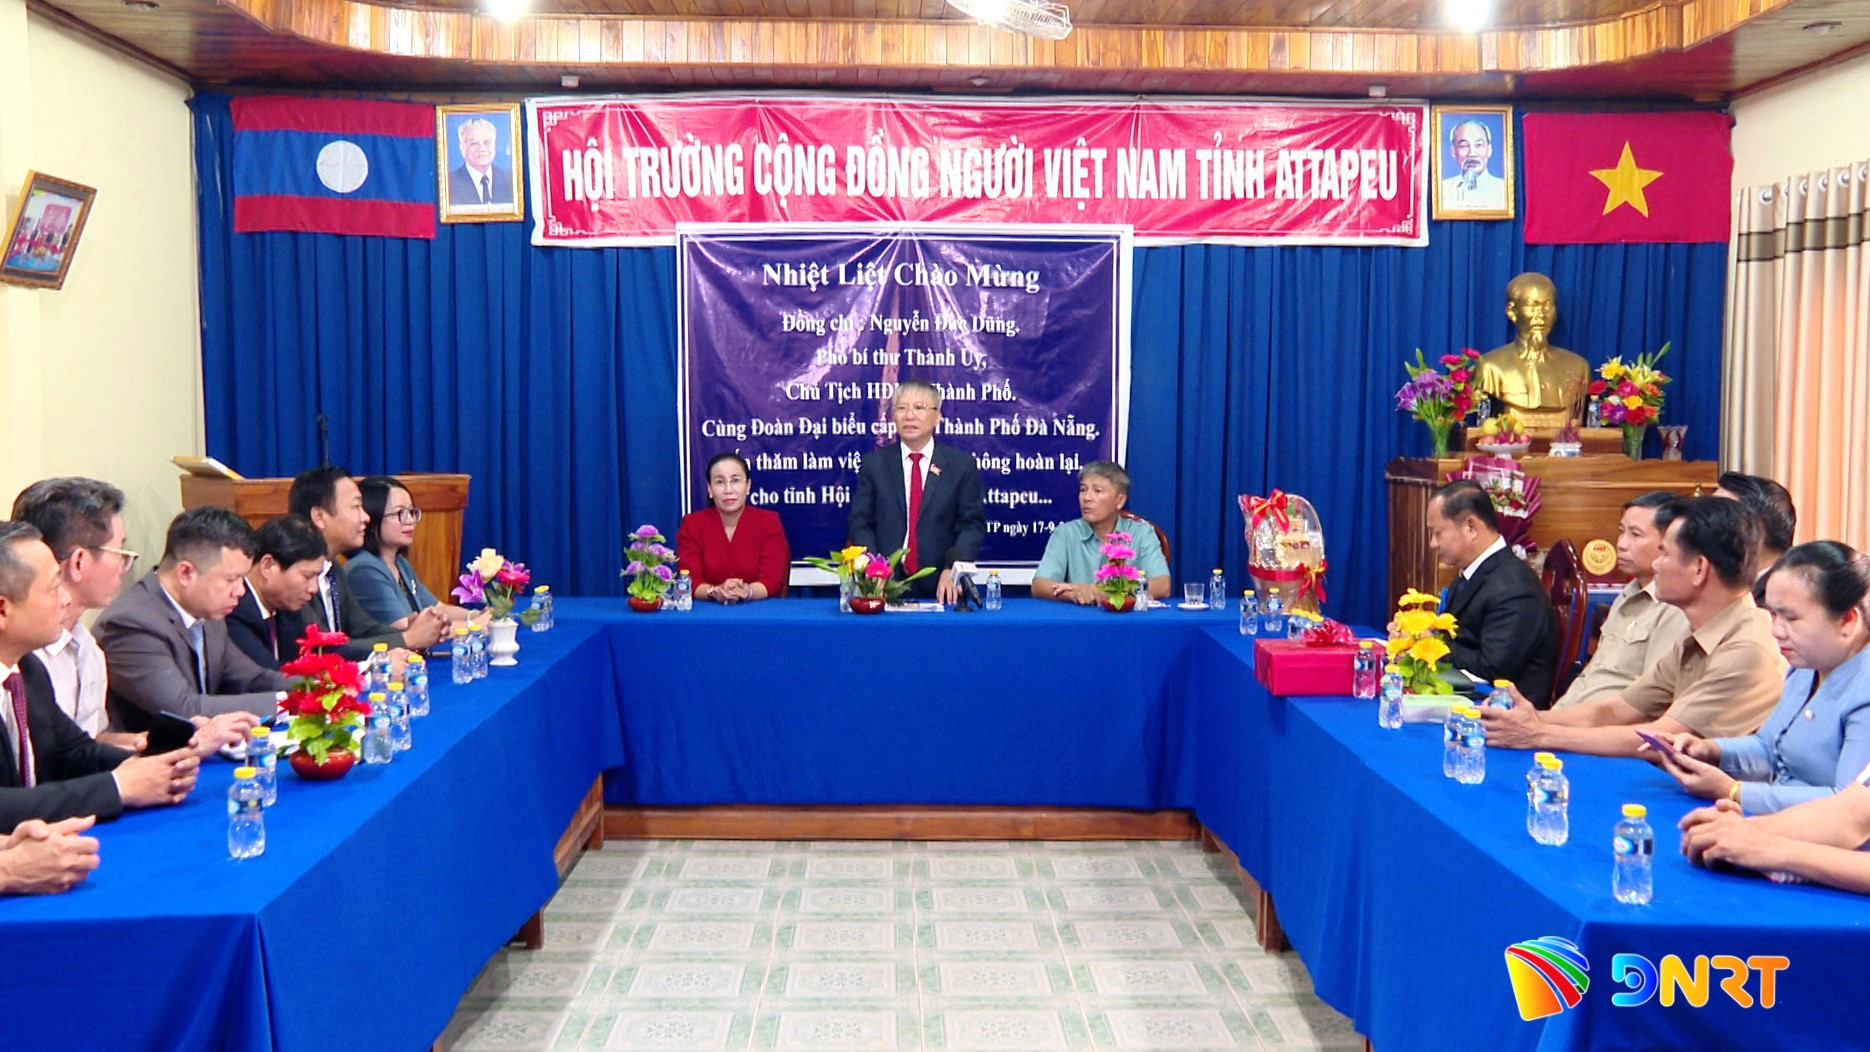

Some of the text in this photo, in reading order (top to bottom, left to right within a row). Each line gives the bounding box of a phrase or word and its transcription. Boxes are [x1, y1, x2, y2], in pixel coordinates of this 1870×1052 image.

[562, 129, 1398, 211] HỘI TRƯỜNG CỘNG ĐỒNG NGƯỜI VIỆT NAM TỈNH ATTAPEU
[762, 261, 1040, 294] Nhiệt Liệt Chào Mừng
[782, 308, 826, 336] Đồng
[870, 310, 930, 336] Nguyễn
[972, 316, 1021, 337] Dũng.
[852, 348, 868, 366] bí
[872, 348, 901, 366] thư
[903, 347, 956, 366] Thành
[825, 382, 862, 404] Tịch
[867, 382, 901, 400] HĐ
[981, 378, 1017, 402] Phố.
[701, 419, 747, 442] Cùng
[751, 417, 794, 436] Đoàn
[798, 417, 827, 440] Đại
[832, 412, 866, 435] biểu
[871, 412, 897, 440] cấp
[989, 412, 1021, 436] Phố
[1025, 417, 1049, 436] Đà
[1052, 414, 1101, 441] Nẵng.
[756, 452, 798, 471] thăm
[803, 452, 833, 471] làm
[838, 451, 862, 474] việ
[1015, 452, 1056, 471] hoàn
[1059, 453, 1084, 475] lại.
[750, 487, 779, 505] cho
[821, 485, 851, 508] Hội
[1003, 520, 1029, 537] ngày
